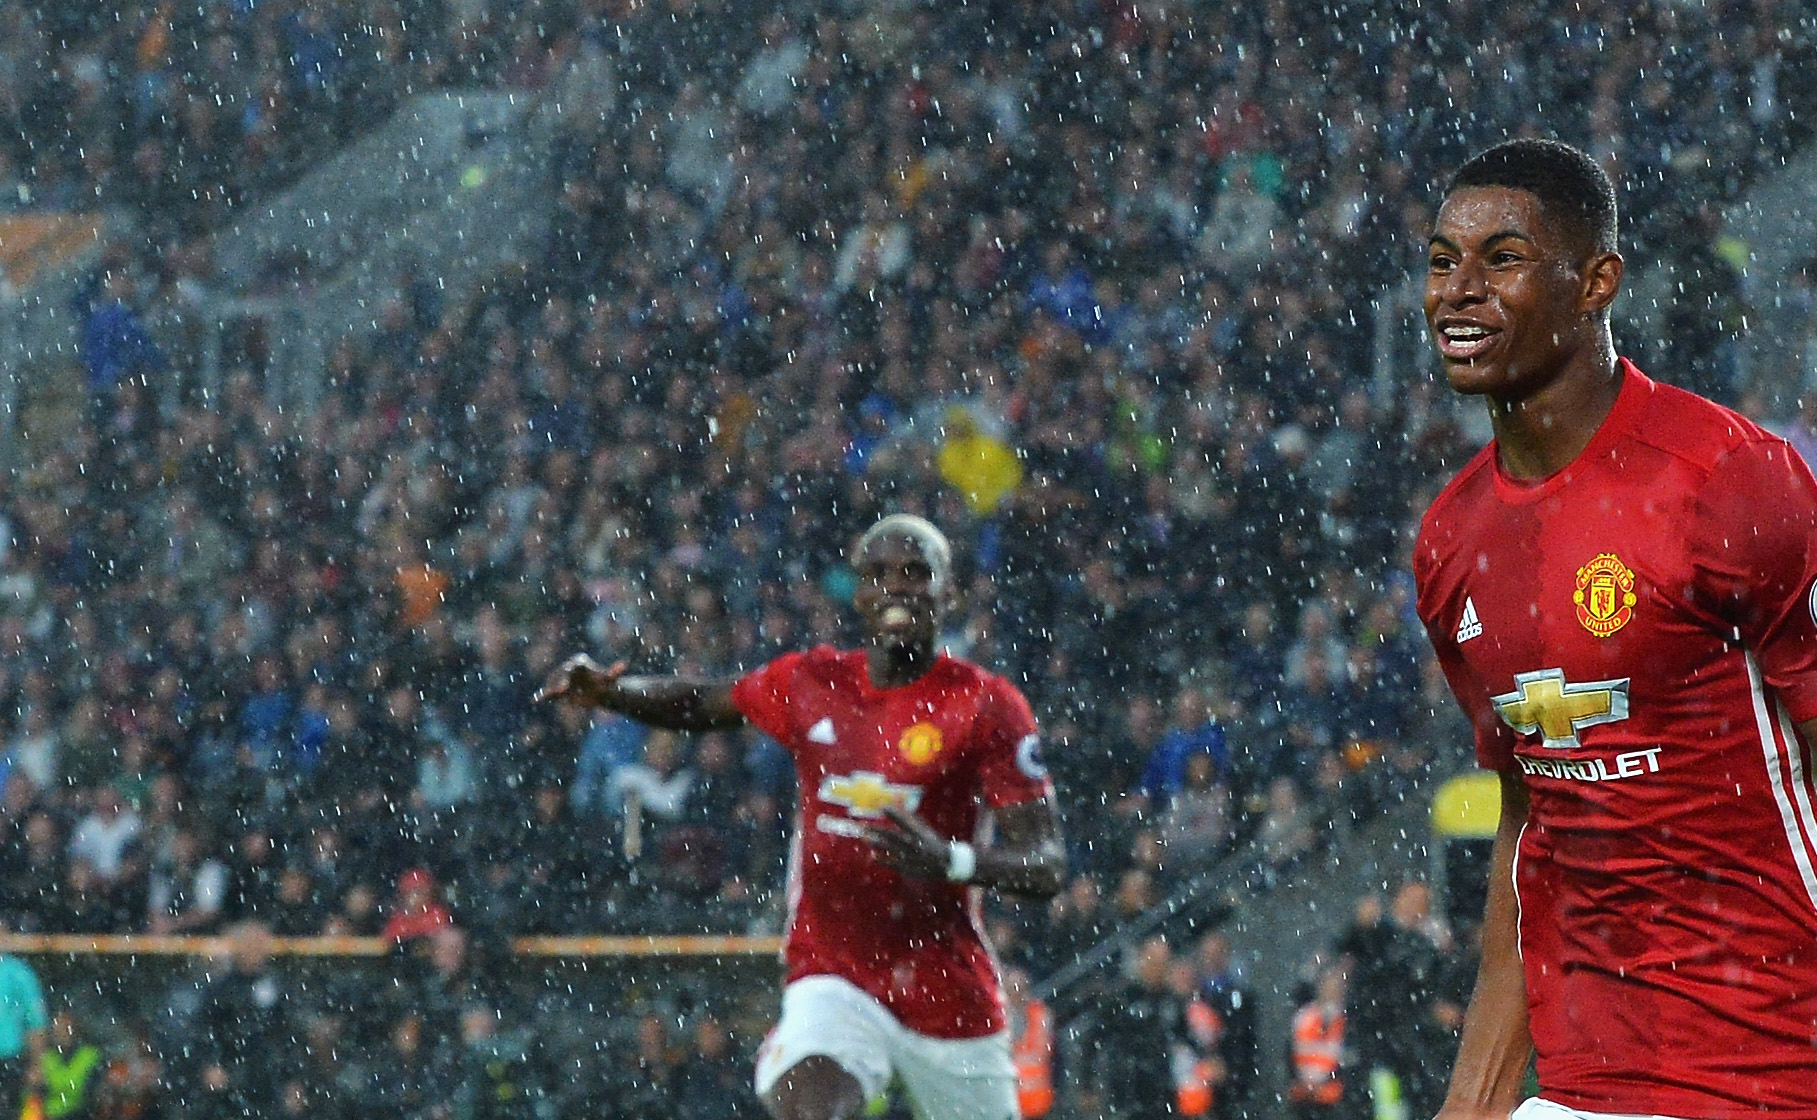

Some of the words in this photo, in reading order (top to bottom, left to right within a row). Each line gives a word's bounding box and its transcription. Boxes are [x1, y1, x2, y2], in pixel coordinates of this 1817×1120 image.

[1580, 559, 1629, 587] MANCHESTER
[1457, 622, 1483, 644] adidas
[1585, 616, 1622, 632] UNITED
[1513, 747, 1663, 782] CHEVROLET
